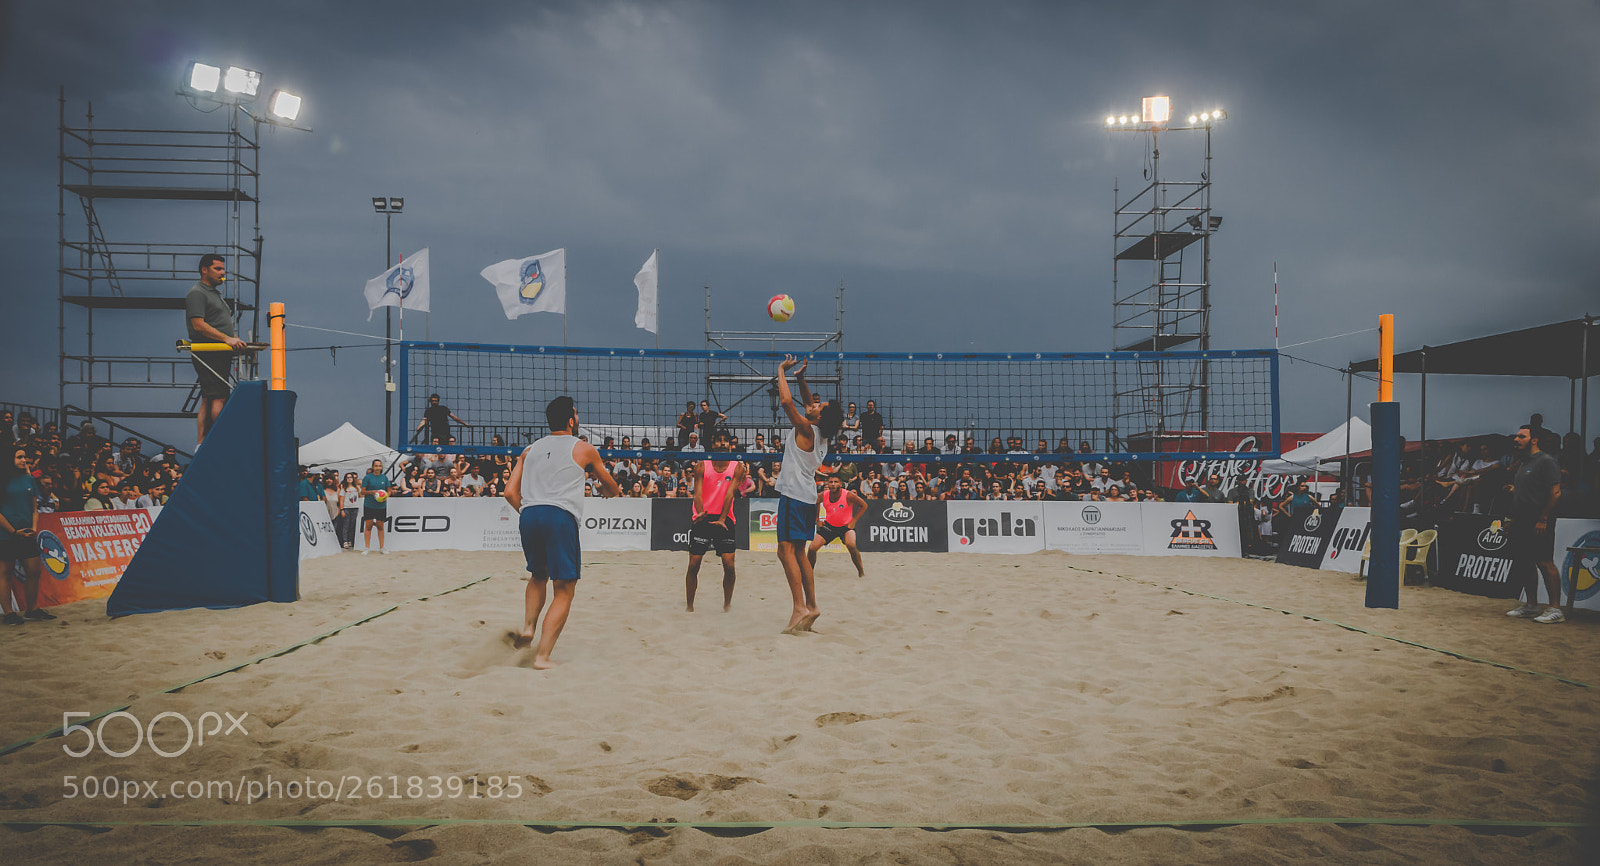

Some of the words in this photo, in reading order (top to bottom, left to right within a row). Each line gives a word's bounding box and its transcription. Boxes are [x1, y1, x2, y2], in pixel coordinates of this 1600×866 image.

[888, 510, 909, 518] Arla
[63, 526, 92, 539] BEACH
[90, 523, 136, 537] VOLLEYBALL
[585, 517, 647, 530] ΟΡΙΖΩΝ
[952, 512, 1036, 545] gala
[870, 525, 929, 543] PROTEIN
[1482, 532, 1503, 544] Arla
[1288, 535, 1322, 555] PROTEIN
[1455, 553, 1513, 583] PROTEIN
